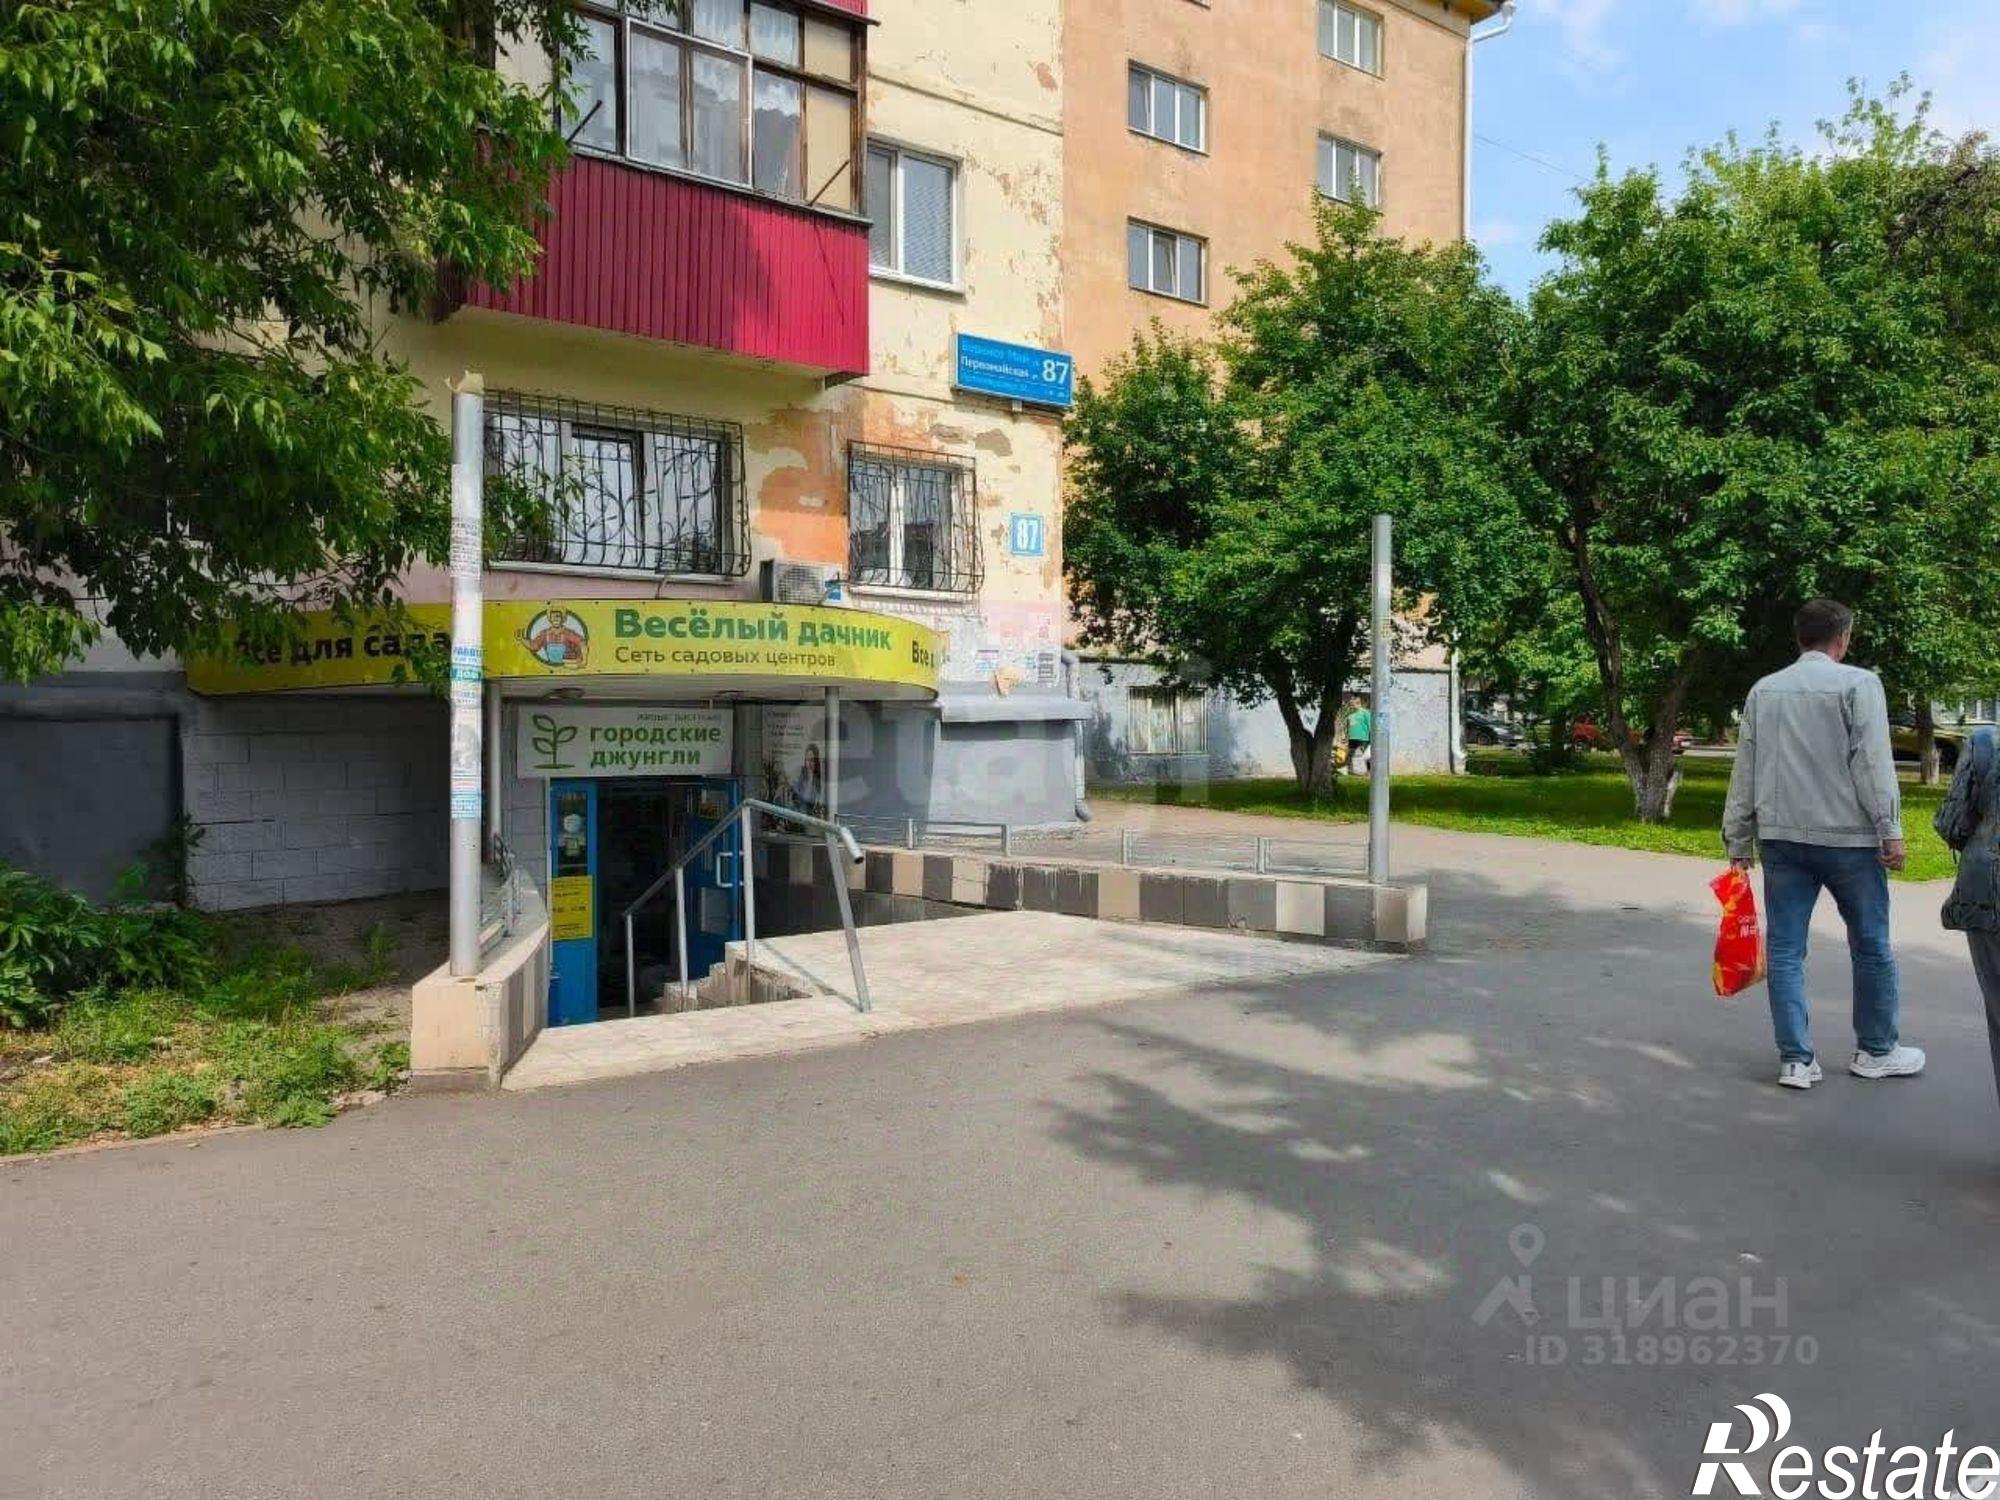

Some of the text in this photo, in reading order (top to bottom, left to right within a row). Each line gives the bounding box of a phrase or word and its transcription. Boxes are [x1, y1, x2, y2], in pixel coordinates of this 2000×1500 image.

[1043, 359, 1069, 385] 87
[1017, 519, 1038, 551] 87
[614, 608, 892, 651] Весёлый дачник
[291, 634, 353, 665] для
[615, 646, 835, 668] Сеть садовых центров
[590, 726, 722, 747] городские
[590, 750, 700, 770] джунгли
